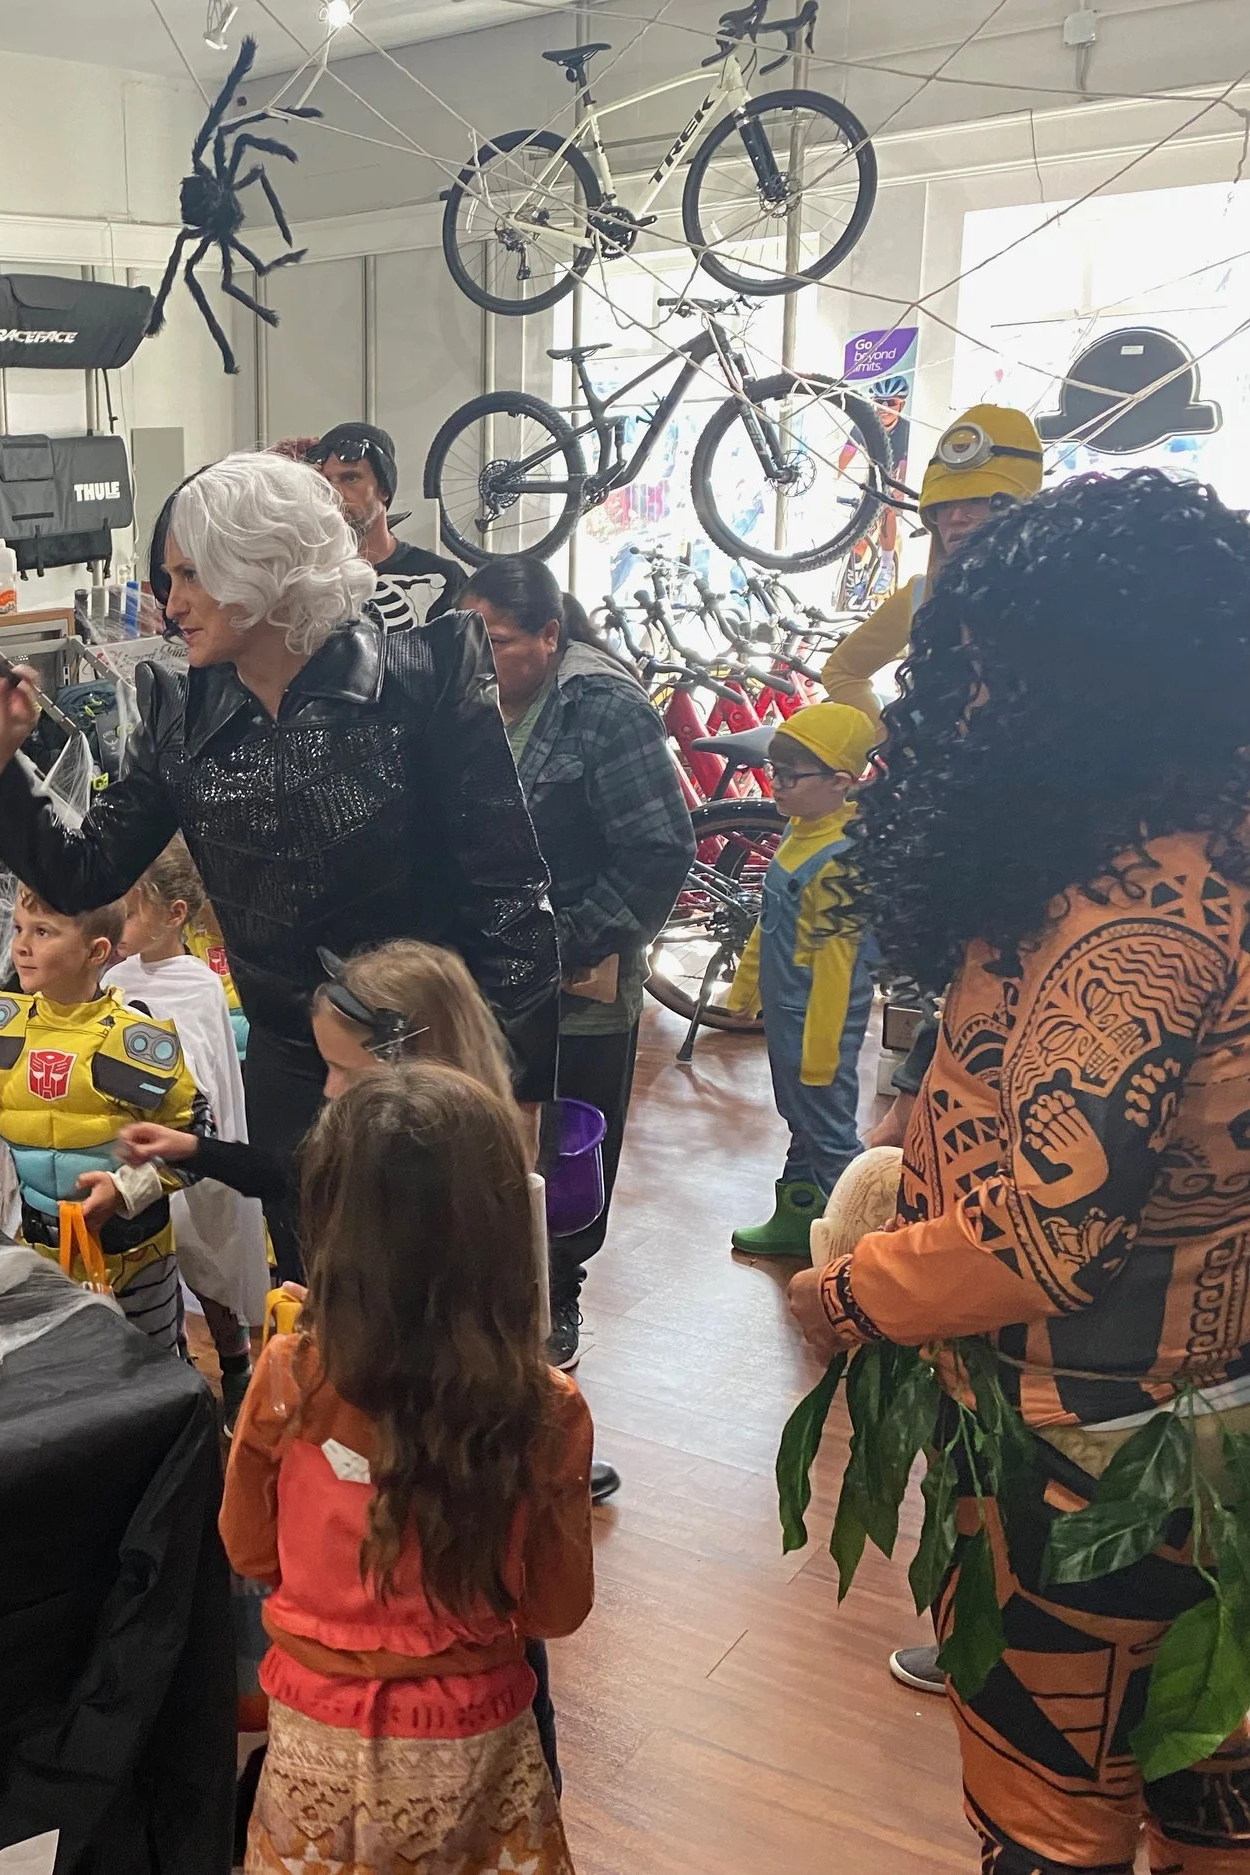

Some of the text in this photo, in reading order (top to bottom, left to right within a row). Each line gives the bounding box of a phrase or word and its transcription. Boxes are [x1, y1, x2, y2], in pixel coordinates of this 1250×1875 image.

[648, 93, 716, 184] TREK
[855, 339, 873, 350] Go
[73, 481, 121, 502] THULE
